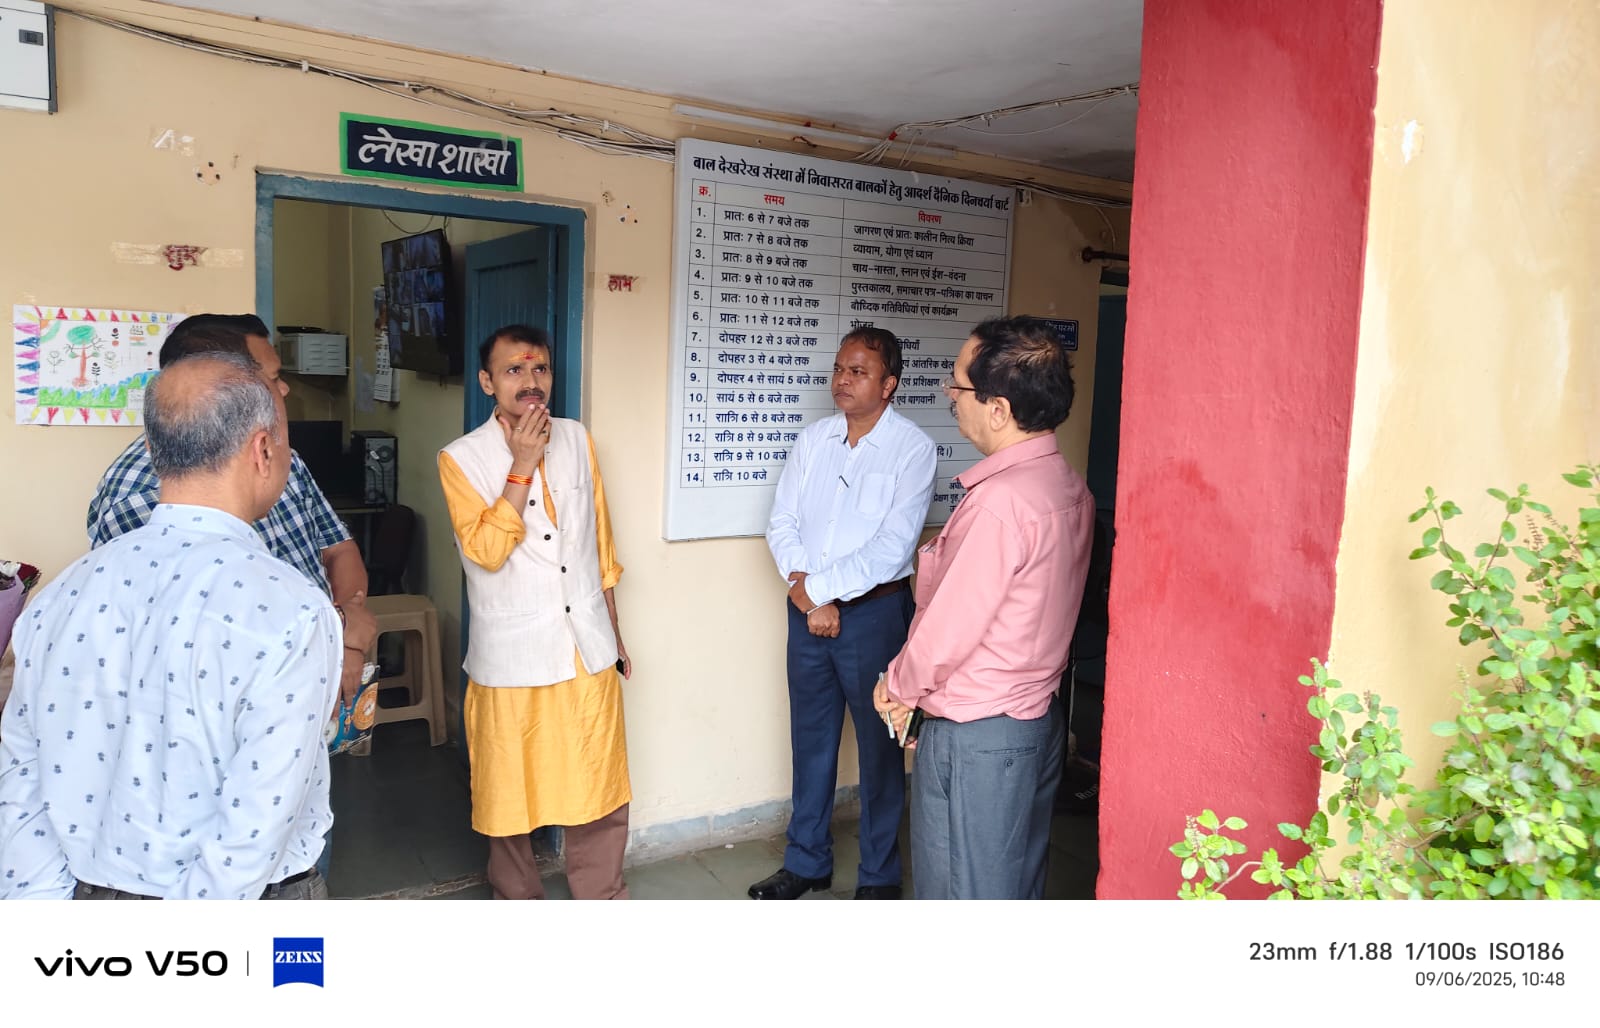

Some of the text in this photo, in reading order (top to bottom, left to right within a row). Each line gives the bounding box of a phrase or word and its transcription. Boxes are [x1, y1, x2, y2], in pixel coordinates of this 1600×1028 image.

[358, 127, 512, 176] लेखा शाखा
[693, 156, 715, 171] बाल
[718, 156, 760, 177] देखरेख
[762, 163, 793, 182] संस्था
[795, 167, 806, 184] में
[808, 168, 853, 190] निवासरत
[855, 179, 887, 195] बालकों
[889, 180, 902, 200] हेतु
[904, 186, 933, 200] आदर्श
[934, 187, 960, 204] दैनिक
[764, 194, 785, 206] समय
[697, 207, 706, 218] 1.
[918, 210, 942, 224] विवरण
[748, 213, 754, 222] 6
[757, 212, 765, 224] से
[768, 216, 774, 224] 7
[778, 215, 792, 227] बजे
[794, 219, 809, 228] तक
[696, 228, 706, 238] 2.
[854, 225, 882, 236] जागरण
[884, 226, 894, 238] एवं
[914, 230, 938, 242] कालीन
[747, 234, 753, 242] 7
[756, 232, 764, 244] से
[768, 236, 774, 245] 8
[776, 234, 790, 248] बजे
[794, 239, 808, 248] तक
[695, 249, 705, 260] 3.
[886, 246, 902, 257] योगा
[904, 248, 914, 260] एवं
[746, 254, 752, 264] 8
[755, 252, 763, 265] से
[766, 256, 772, 265] 9
[776, 256, 790, 268] बजे
[792, 259, 808, 268] तक
[694, 270, 704, 280] 4.
[900, 267, 919, 278] स्नान
[920, 267, 930, 280] एवं
[744, 274, 751, 283] 9
[754, 272, 762, 284] से
[766, 276, 778, 286] 10
[782, 275, 796, 288] बजे
[798, 278, 814, 288] तक
[694, 290, 704, 300] 5.
[896, 285, 923, 296] समाचार
[965, 292, 974, 300] का
[746, 294, 758, 304] 10
[761, 292, 769, 305] से
[774, 296, 784, 306] 11
[788, 295, 802, 308] बजे
[804, 300, 820, 308] तक
[920, 304, 930, 316] एवं
[932, 304, 959, 316] कार्यक्रम
[692, 312, 703, 322] 6.
[745, 315, 756, 324] 11
[760, 312, 768, 326] से
[772, 316, 784, 326] 12
[787, 315, 802, 327] बजे
[804, 318, 819, 328] तक
[691, 332, 702, 342] 7.
[719, 330, 818, 346] दोपहर 12 से 3 बजे तक
[690, 352, 702, 362] 8.
[718, 350, 810, 366] दोपहर 3 से 4 बजे तक
[912, 358, 940, 369] आंतरिक
[690, 372, 700, 382] 9.
[718, 370, 828, 386] दोपहर 4 से सायं 5 बजे तक
[902, 376, 940, 388] एवं प्रशिक्षण
[690, 393, 706, 404] 10.
[716, 390, 800, 404] सायं 5 से 6 बजे तक
[896, 393, 906, 406] एवं
[908, 393, 936, 404] बागवानी
[688, 413, 705, 423] 11.
[742, 414, 748, 423] 6
[750, 412, 758, 423] से
[762, 414, 768, 422] 8
[770, 412, 785, 423] बजे
[788, 414, 802, 423] तक
[688, 434, 704, 443] 12.
[715, 430, 799, 442] रात्रि 8 से 9 बजे तक
[688, 453, 704, 462] 13.
[714, 449, 787, 462] रात्रि 9 से 10 बजे
[686, 472, 703, 482] 14.
[714, 468, 768, 481] रात्रि 10 बजे
